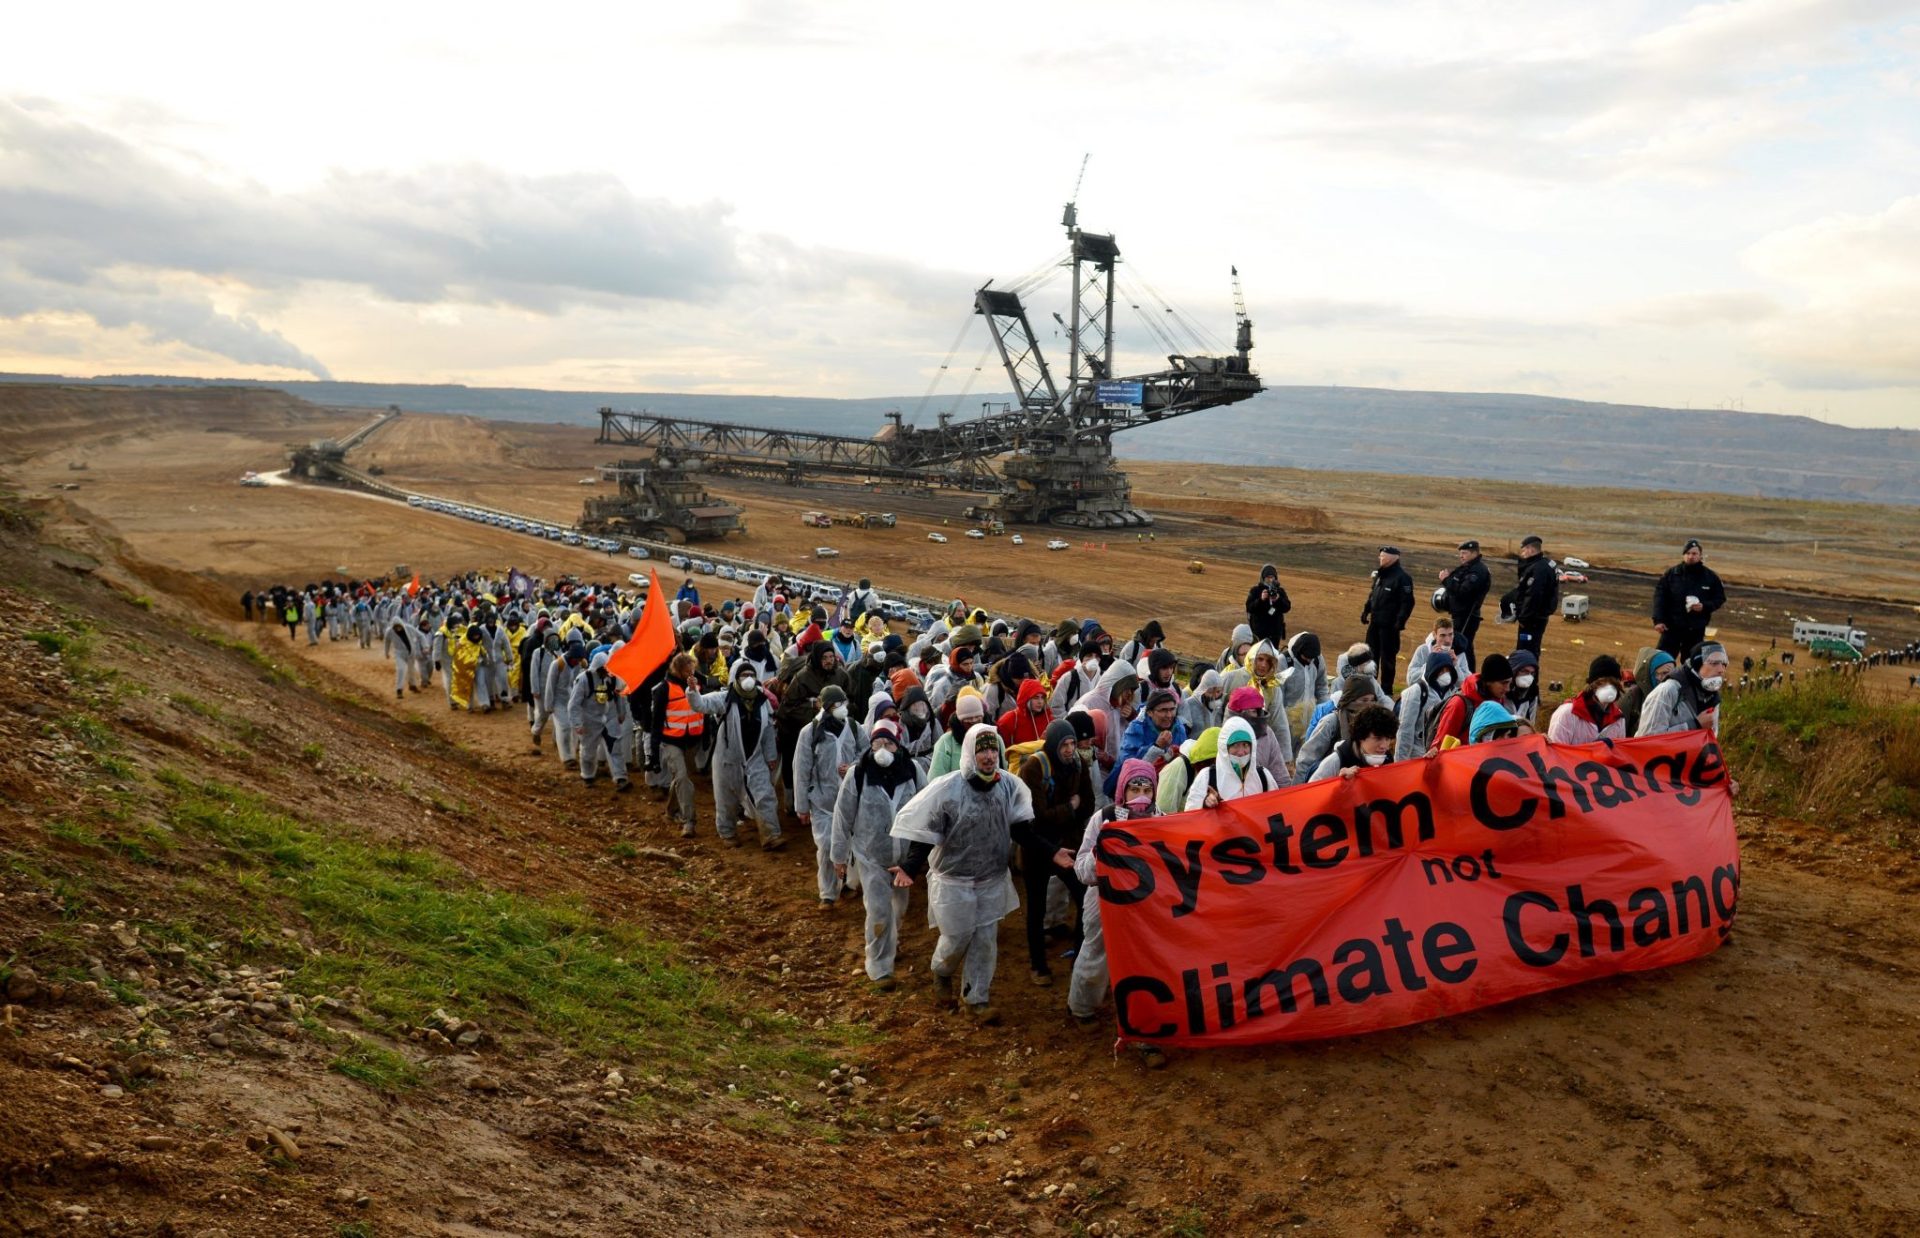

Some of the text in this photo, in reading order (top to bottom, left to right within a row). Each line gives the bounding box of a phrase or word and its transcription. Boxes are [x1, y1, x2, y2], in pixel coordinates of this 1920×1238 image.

[1097, 790, 1436, 918] System
[1421, 848, 1502, 885] not
[1114, 863, 1738, 1038] Climate Chang
